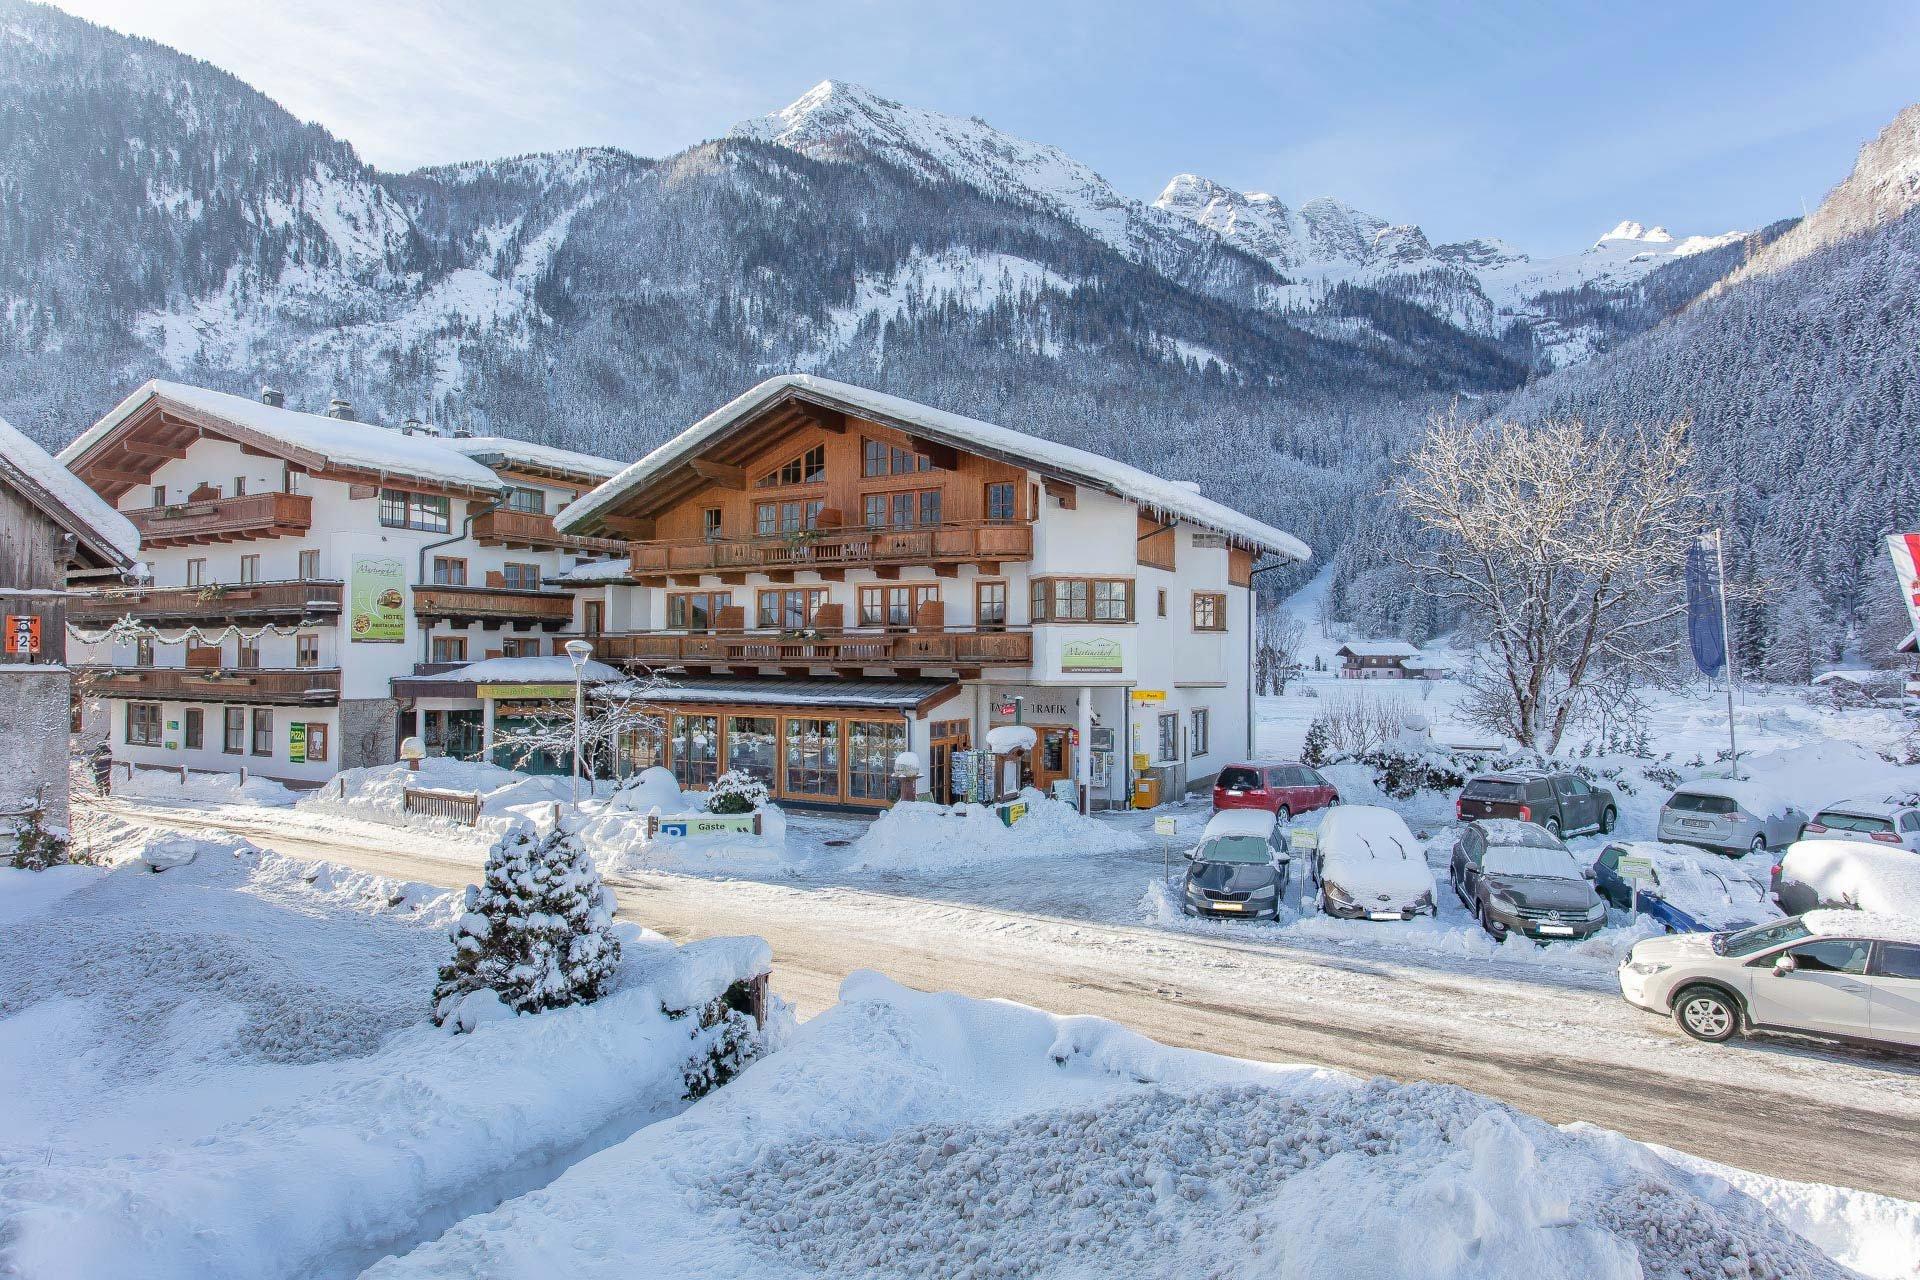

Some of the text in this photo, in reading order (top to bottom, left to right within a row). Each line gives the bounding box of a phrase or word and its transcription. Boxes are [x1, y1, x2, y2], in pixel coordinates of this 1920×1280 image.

[9, 635, 39, 648] 1-2-3
[1031, 704, 1068, 715] TRAFIK
[290, 730, 305, 741] PIZZA
